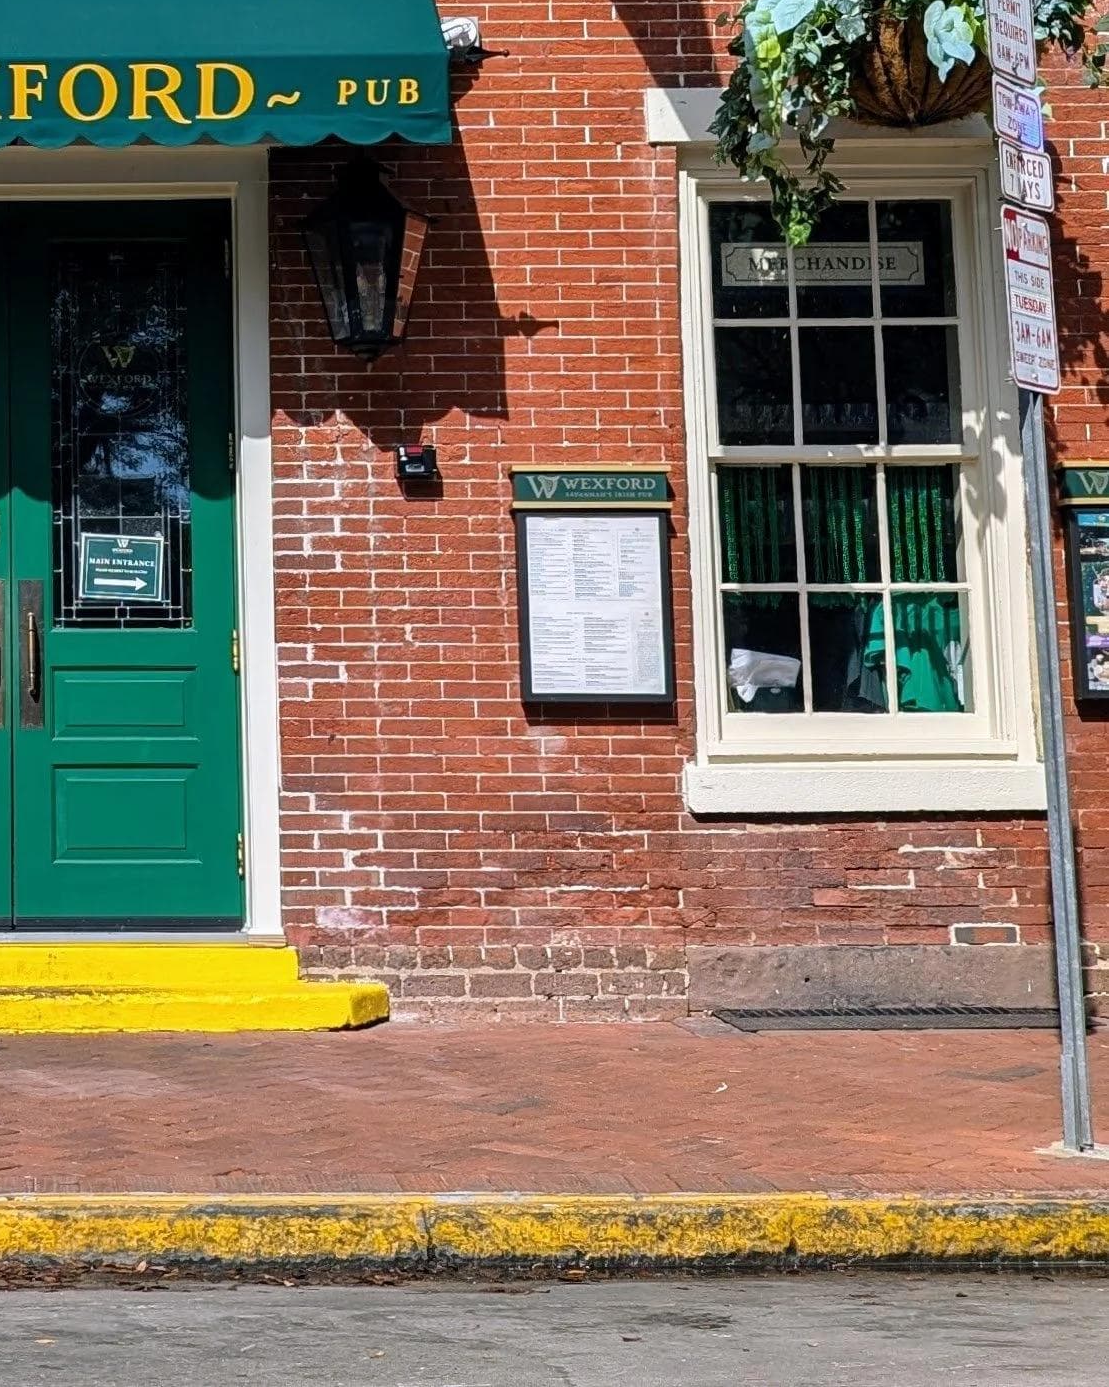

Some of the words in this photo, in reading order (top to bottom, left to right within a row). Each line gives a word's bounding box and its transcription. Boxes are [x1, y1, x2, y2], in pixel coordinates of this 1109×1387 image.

[994, 14, 1028, 45] REQUIRED
[337, 78, 420, 106] PUB
[998, 92, 1036, 118] TOW-AWAY
[1007, 116, 1028, 137] ZONE
[1005, 150, 1044, 179] ENFORCED
[1004, 217, 1019, 253] NO
[1018, 228, 1048, 255] PARKING
[748, 256, 897, 272] MERCHANDISE
[1014, 270, 1028, 285] THIS
[1031, 275, 1045, 290] SIDE
[1014, 294, 1047, 315] TUESDAY
[1015, 321, 1052, 350] 3AM-6AM
[562, 477, 656, 490] WEXFORD
[89, 557, 110, 565] MAIN
[112, 559, 155, 567] ENTRANCE
